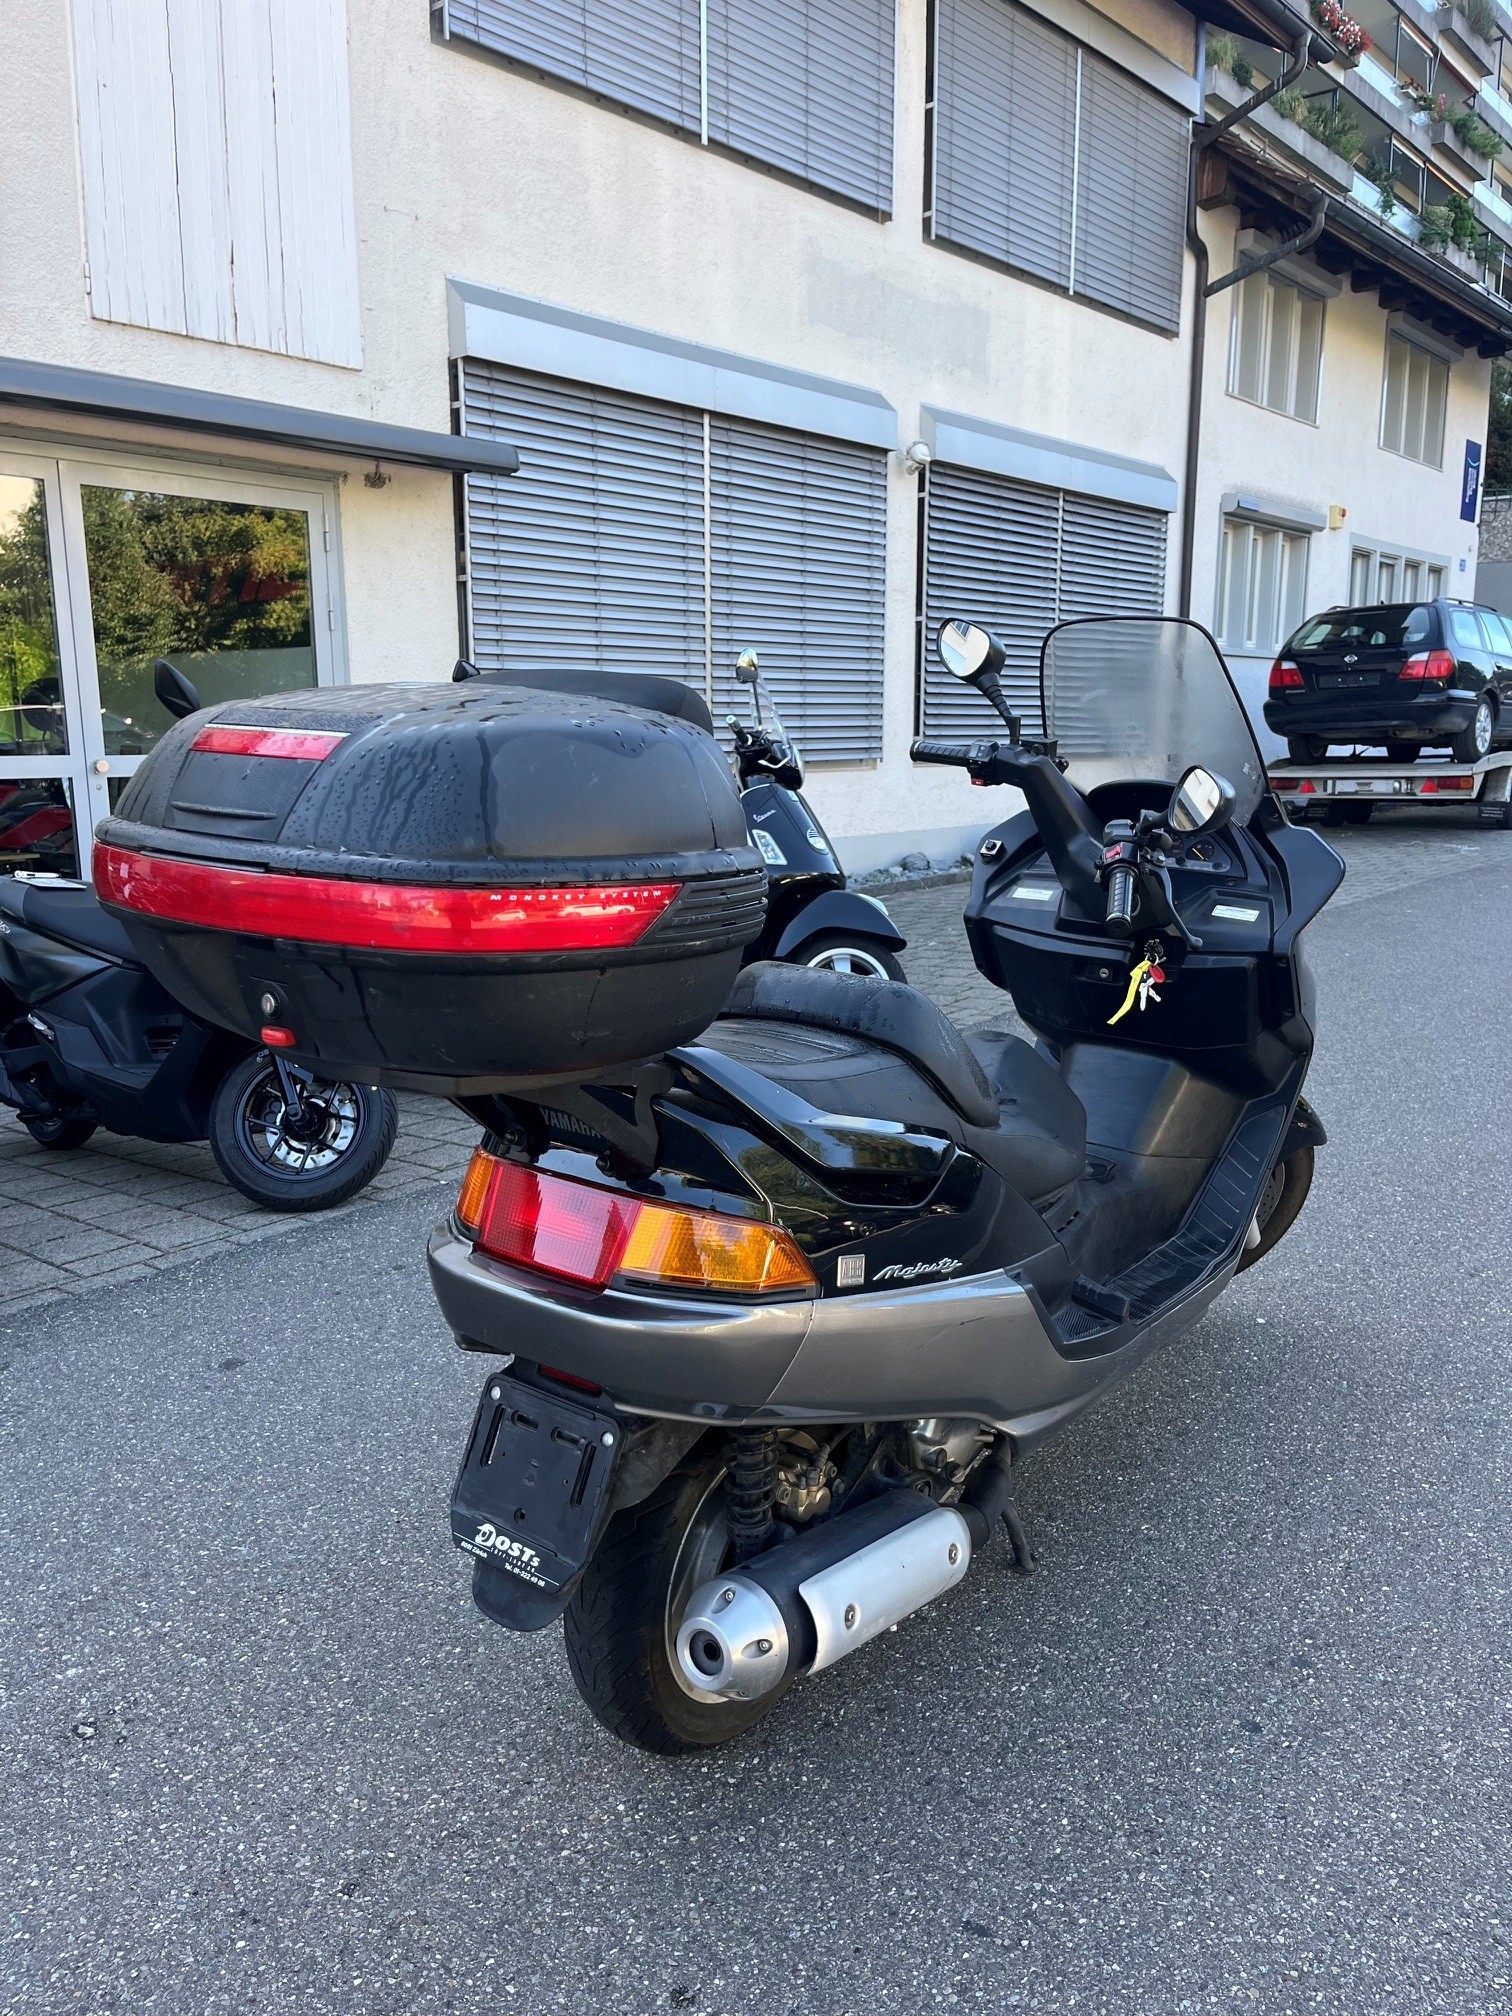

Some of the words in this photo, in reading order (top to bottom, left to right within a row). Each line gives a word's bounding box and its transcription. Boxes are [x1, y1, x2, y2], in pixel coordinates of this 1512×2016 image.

[490, 893, 585, 901] MONOKEY
[600, 890, 661, 899] SYSTEM
[872, 1257, 963, 1280] Majesty
